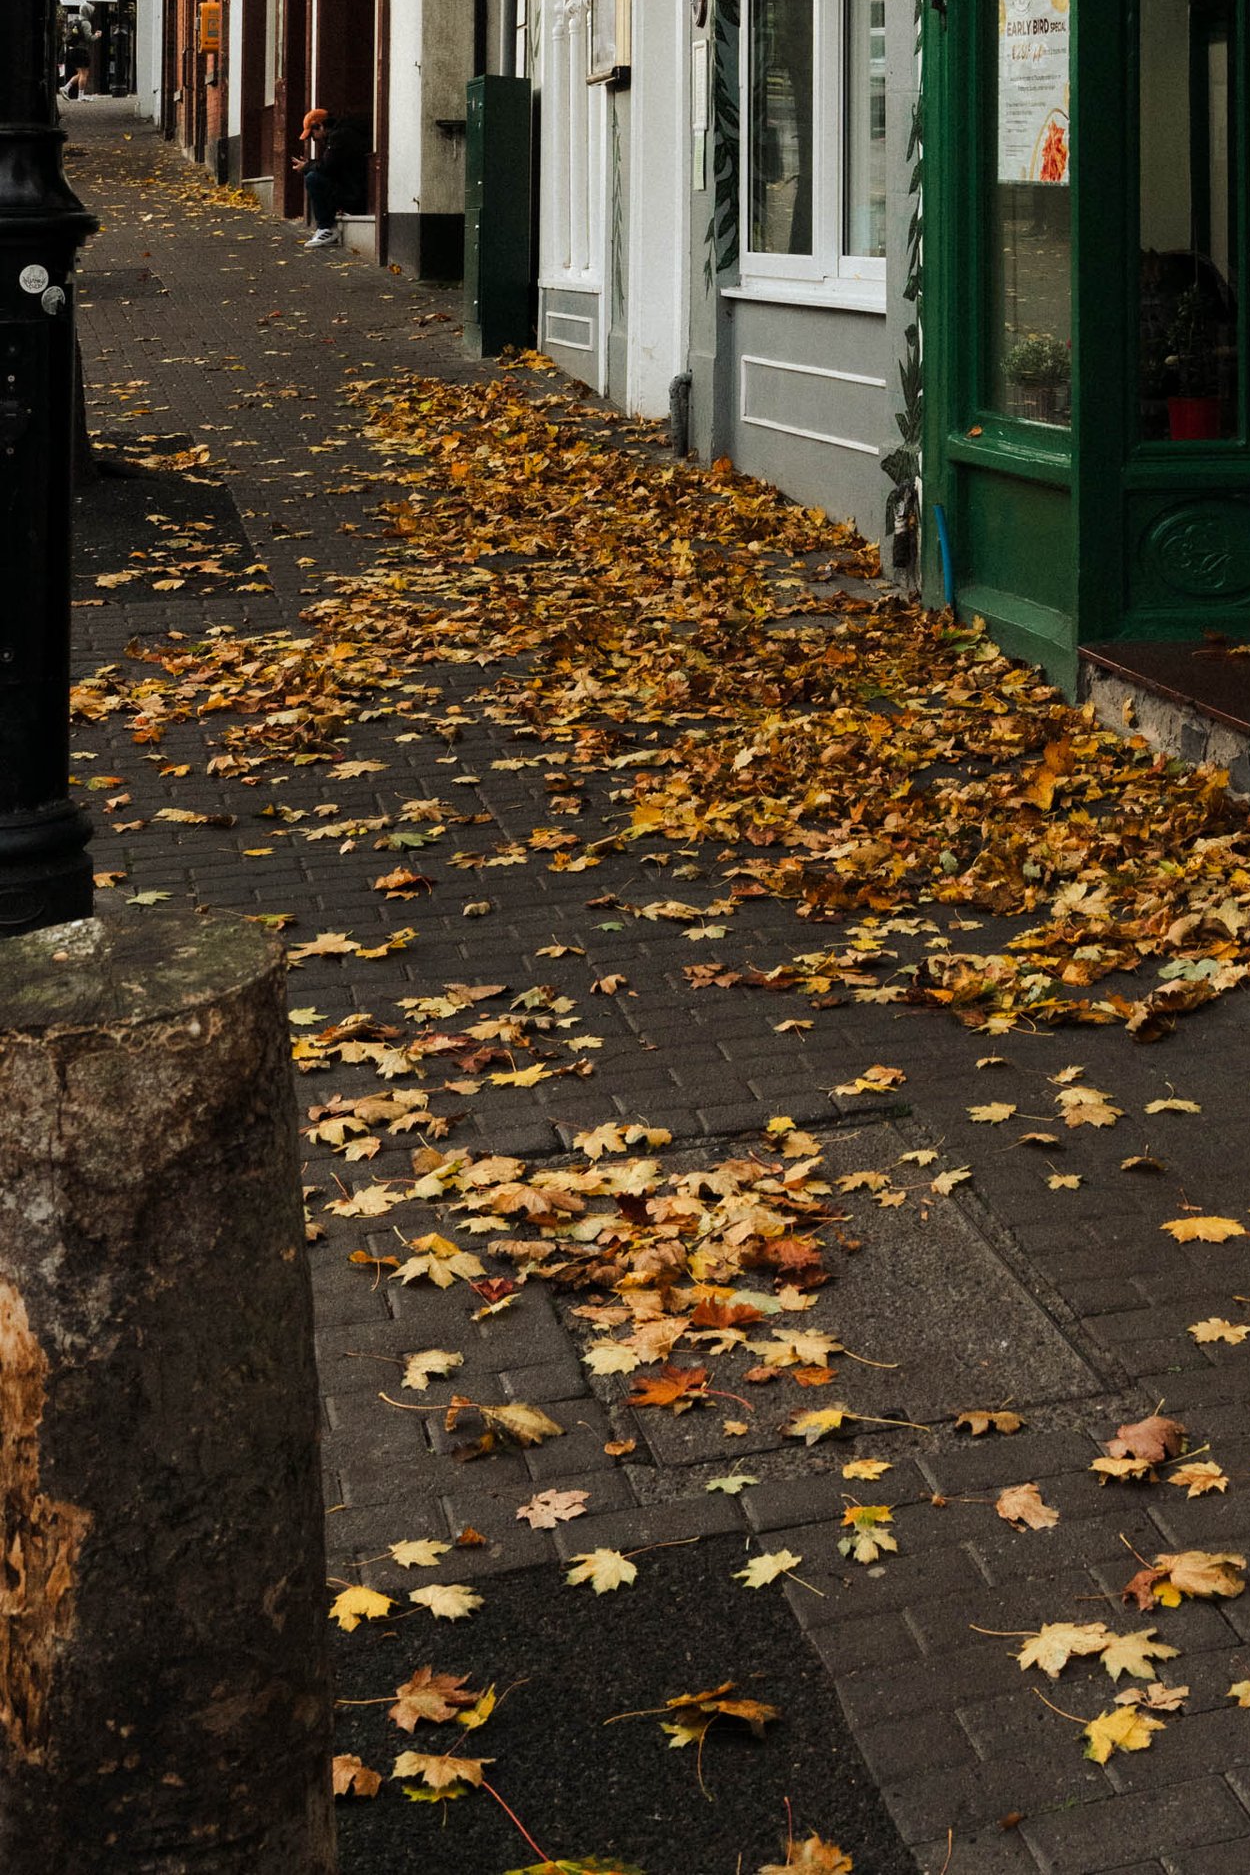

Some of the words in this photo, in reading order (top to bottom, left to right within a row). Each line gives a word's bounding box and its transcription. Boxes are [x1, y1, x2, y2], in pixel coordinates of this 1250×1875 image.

[1006, 20, 1031, 37] EARLY
[1033, 18, 1049, 35] BIRD
[1050, 21, 1067, 34] SPECIAL
